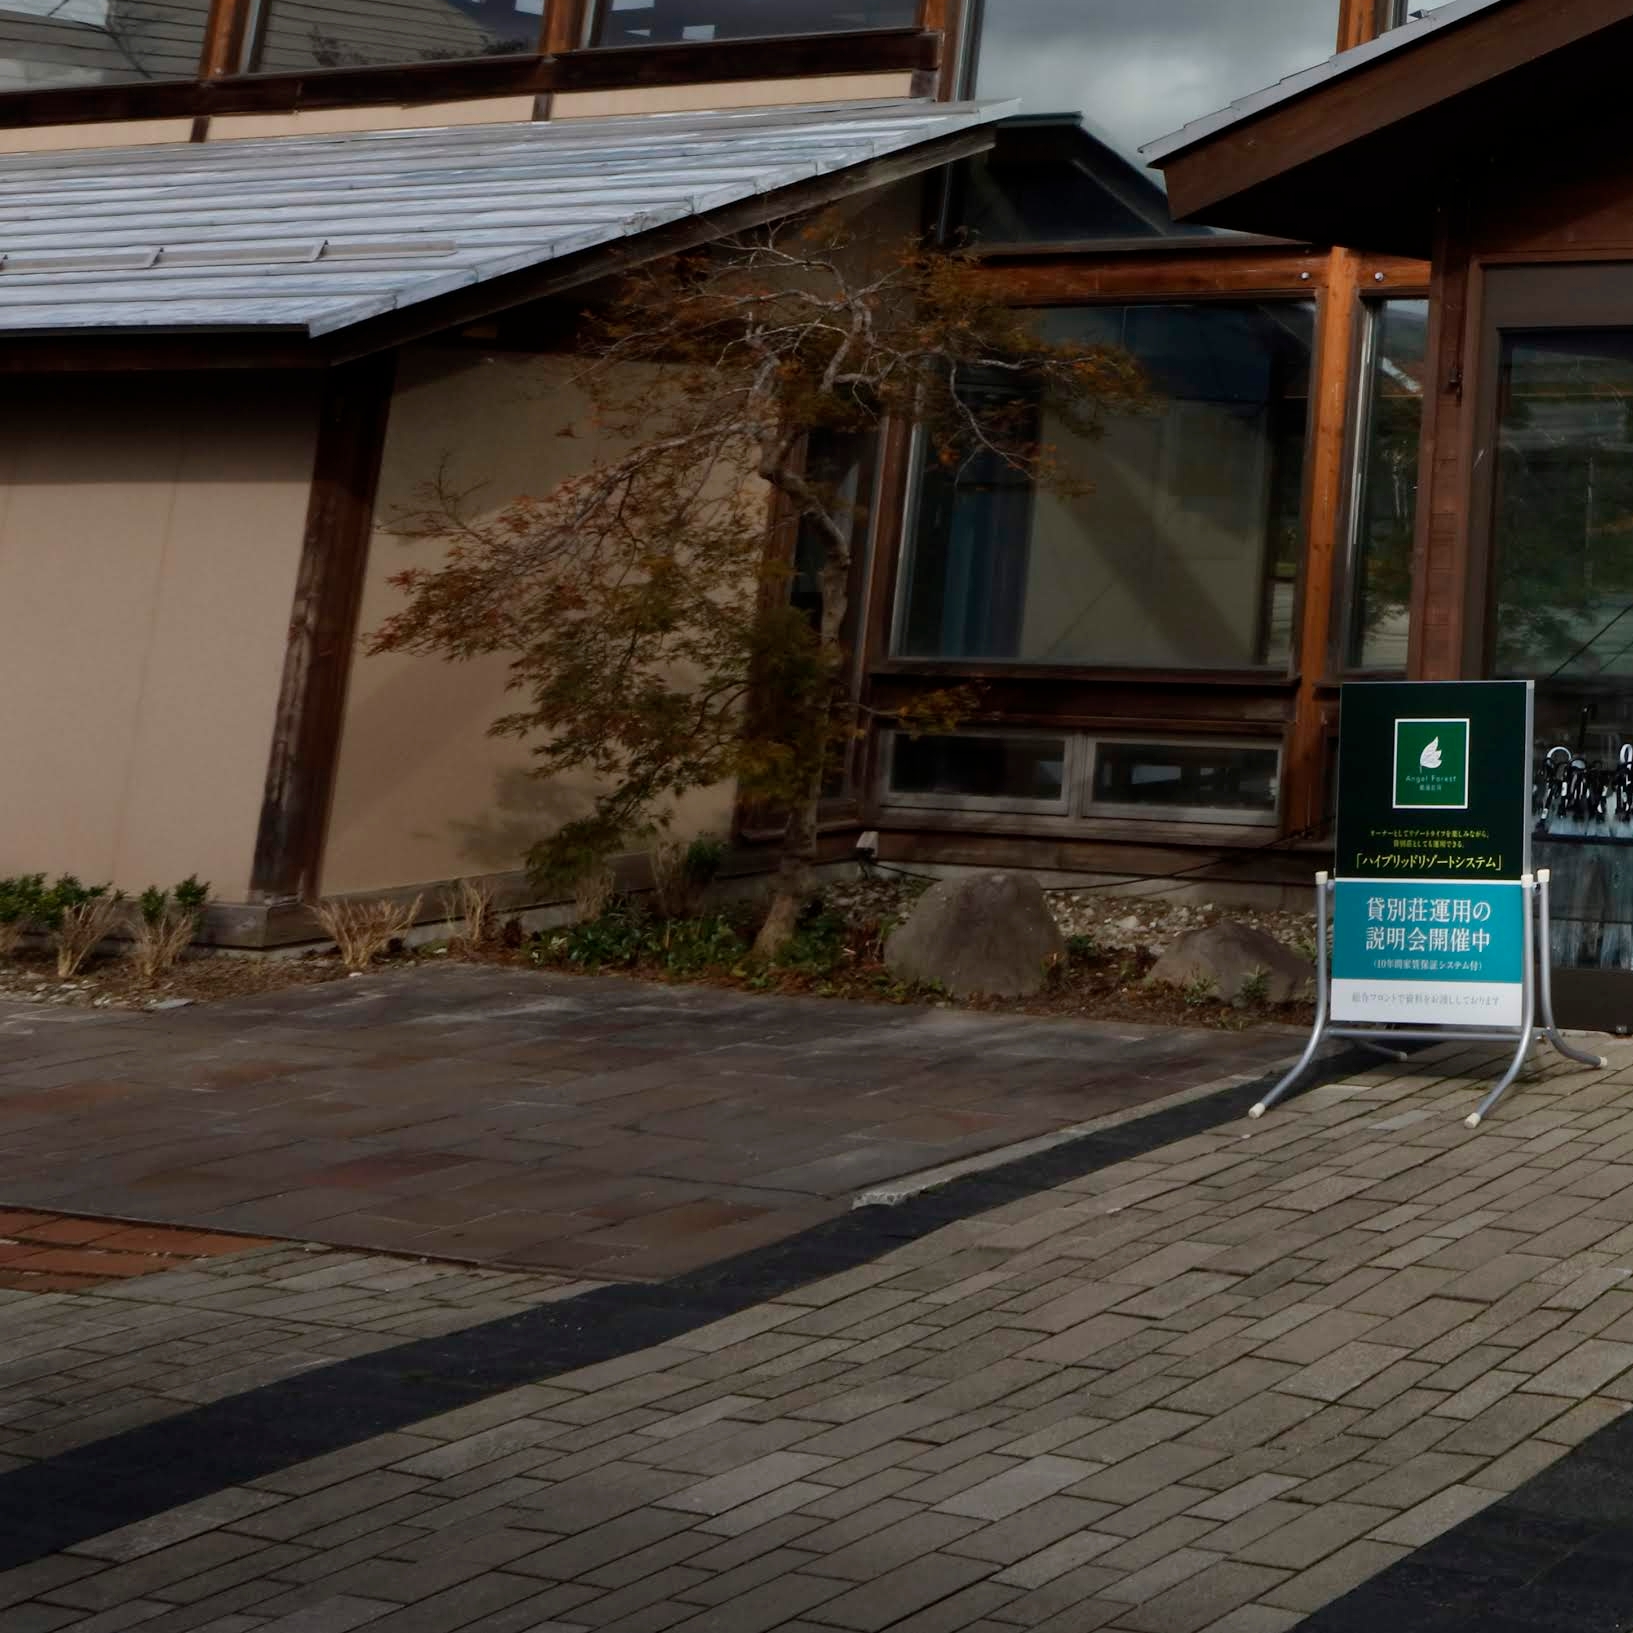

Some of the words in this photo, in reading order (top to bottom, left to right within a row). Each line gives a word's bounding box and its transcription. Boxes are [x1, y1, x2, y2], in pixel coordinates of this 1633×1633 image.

[1405, 775, 1428, 784] Angel
[1431, 774, 1457, 783] Forest
[1355, 852, 1503, 872] 「ハイブリッドリゾートシステム」
[1366, 896, 1492, 924] 貸別荘運用の
[1365, 926, 1491, 953] 説明会開催中
